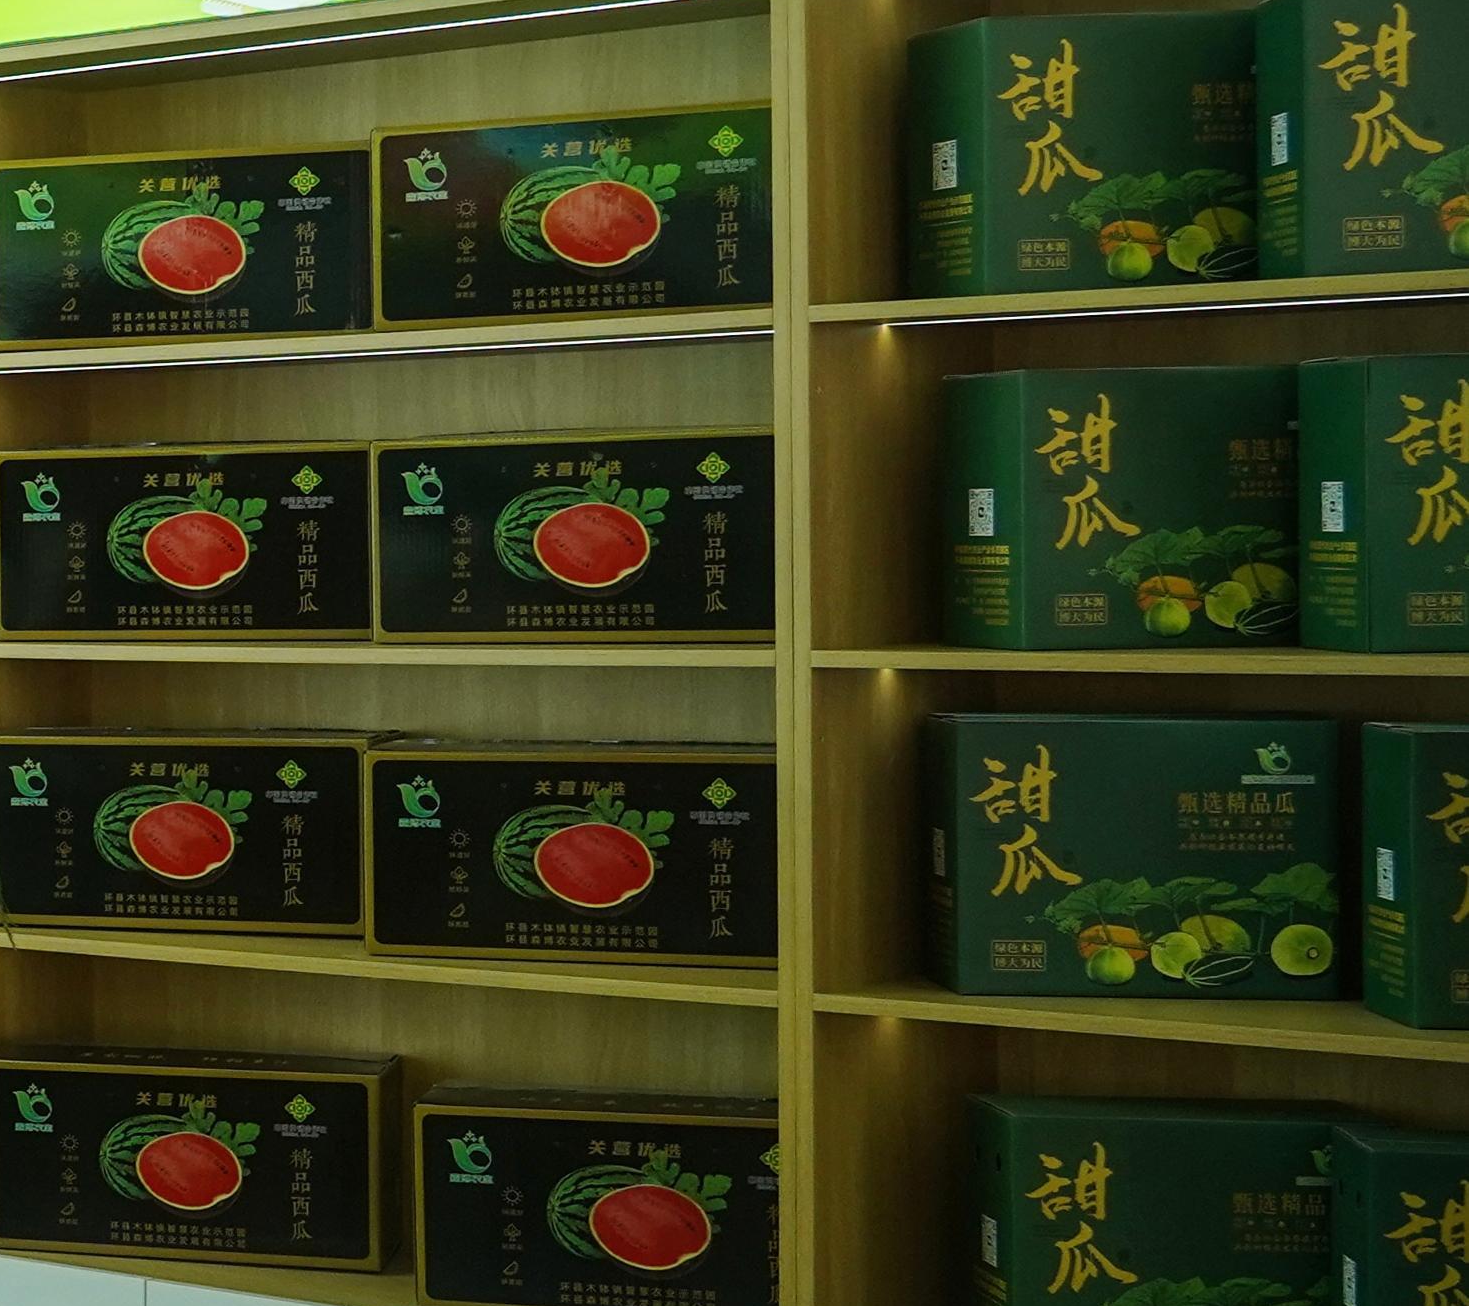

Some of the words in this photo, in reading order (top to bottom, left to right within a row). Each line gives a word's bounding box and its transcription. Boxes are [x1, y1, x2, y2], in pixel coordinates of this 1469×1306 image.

[997, 37, 1104, 197] 甜瓜
[1318, 2, 1445, 171] 甜瓜
[293, 220, 318, 317] 精品西瓜
[715, 184, 741, 289] 精品西瓜
[1034, 393, 1142, 550] 甜瓜
[296, 519, 320, 615] 精品西瓜
[702, 511, 729, 614] 精品西瓜
[968, 743, 1083, 898] 甜瓜
[1176, 791, 1296, 815] 甄选精品瓜
[281, 813, 305, 907] 精品西瓜
[708, 836, 735, 940] 精品西瓜
[290, 1148, 314, 1241] 精品西瓜
[1025, 1141, 1138, 1295] 甜瓜
